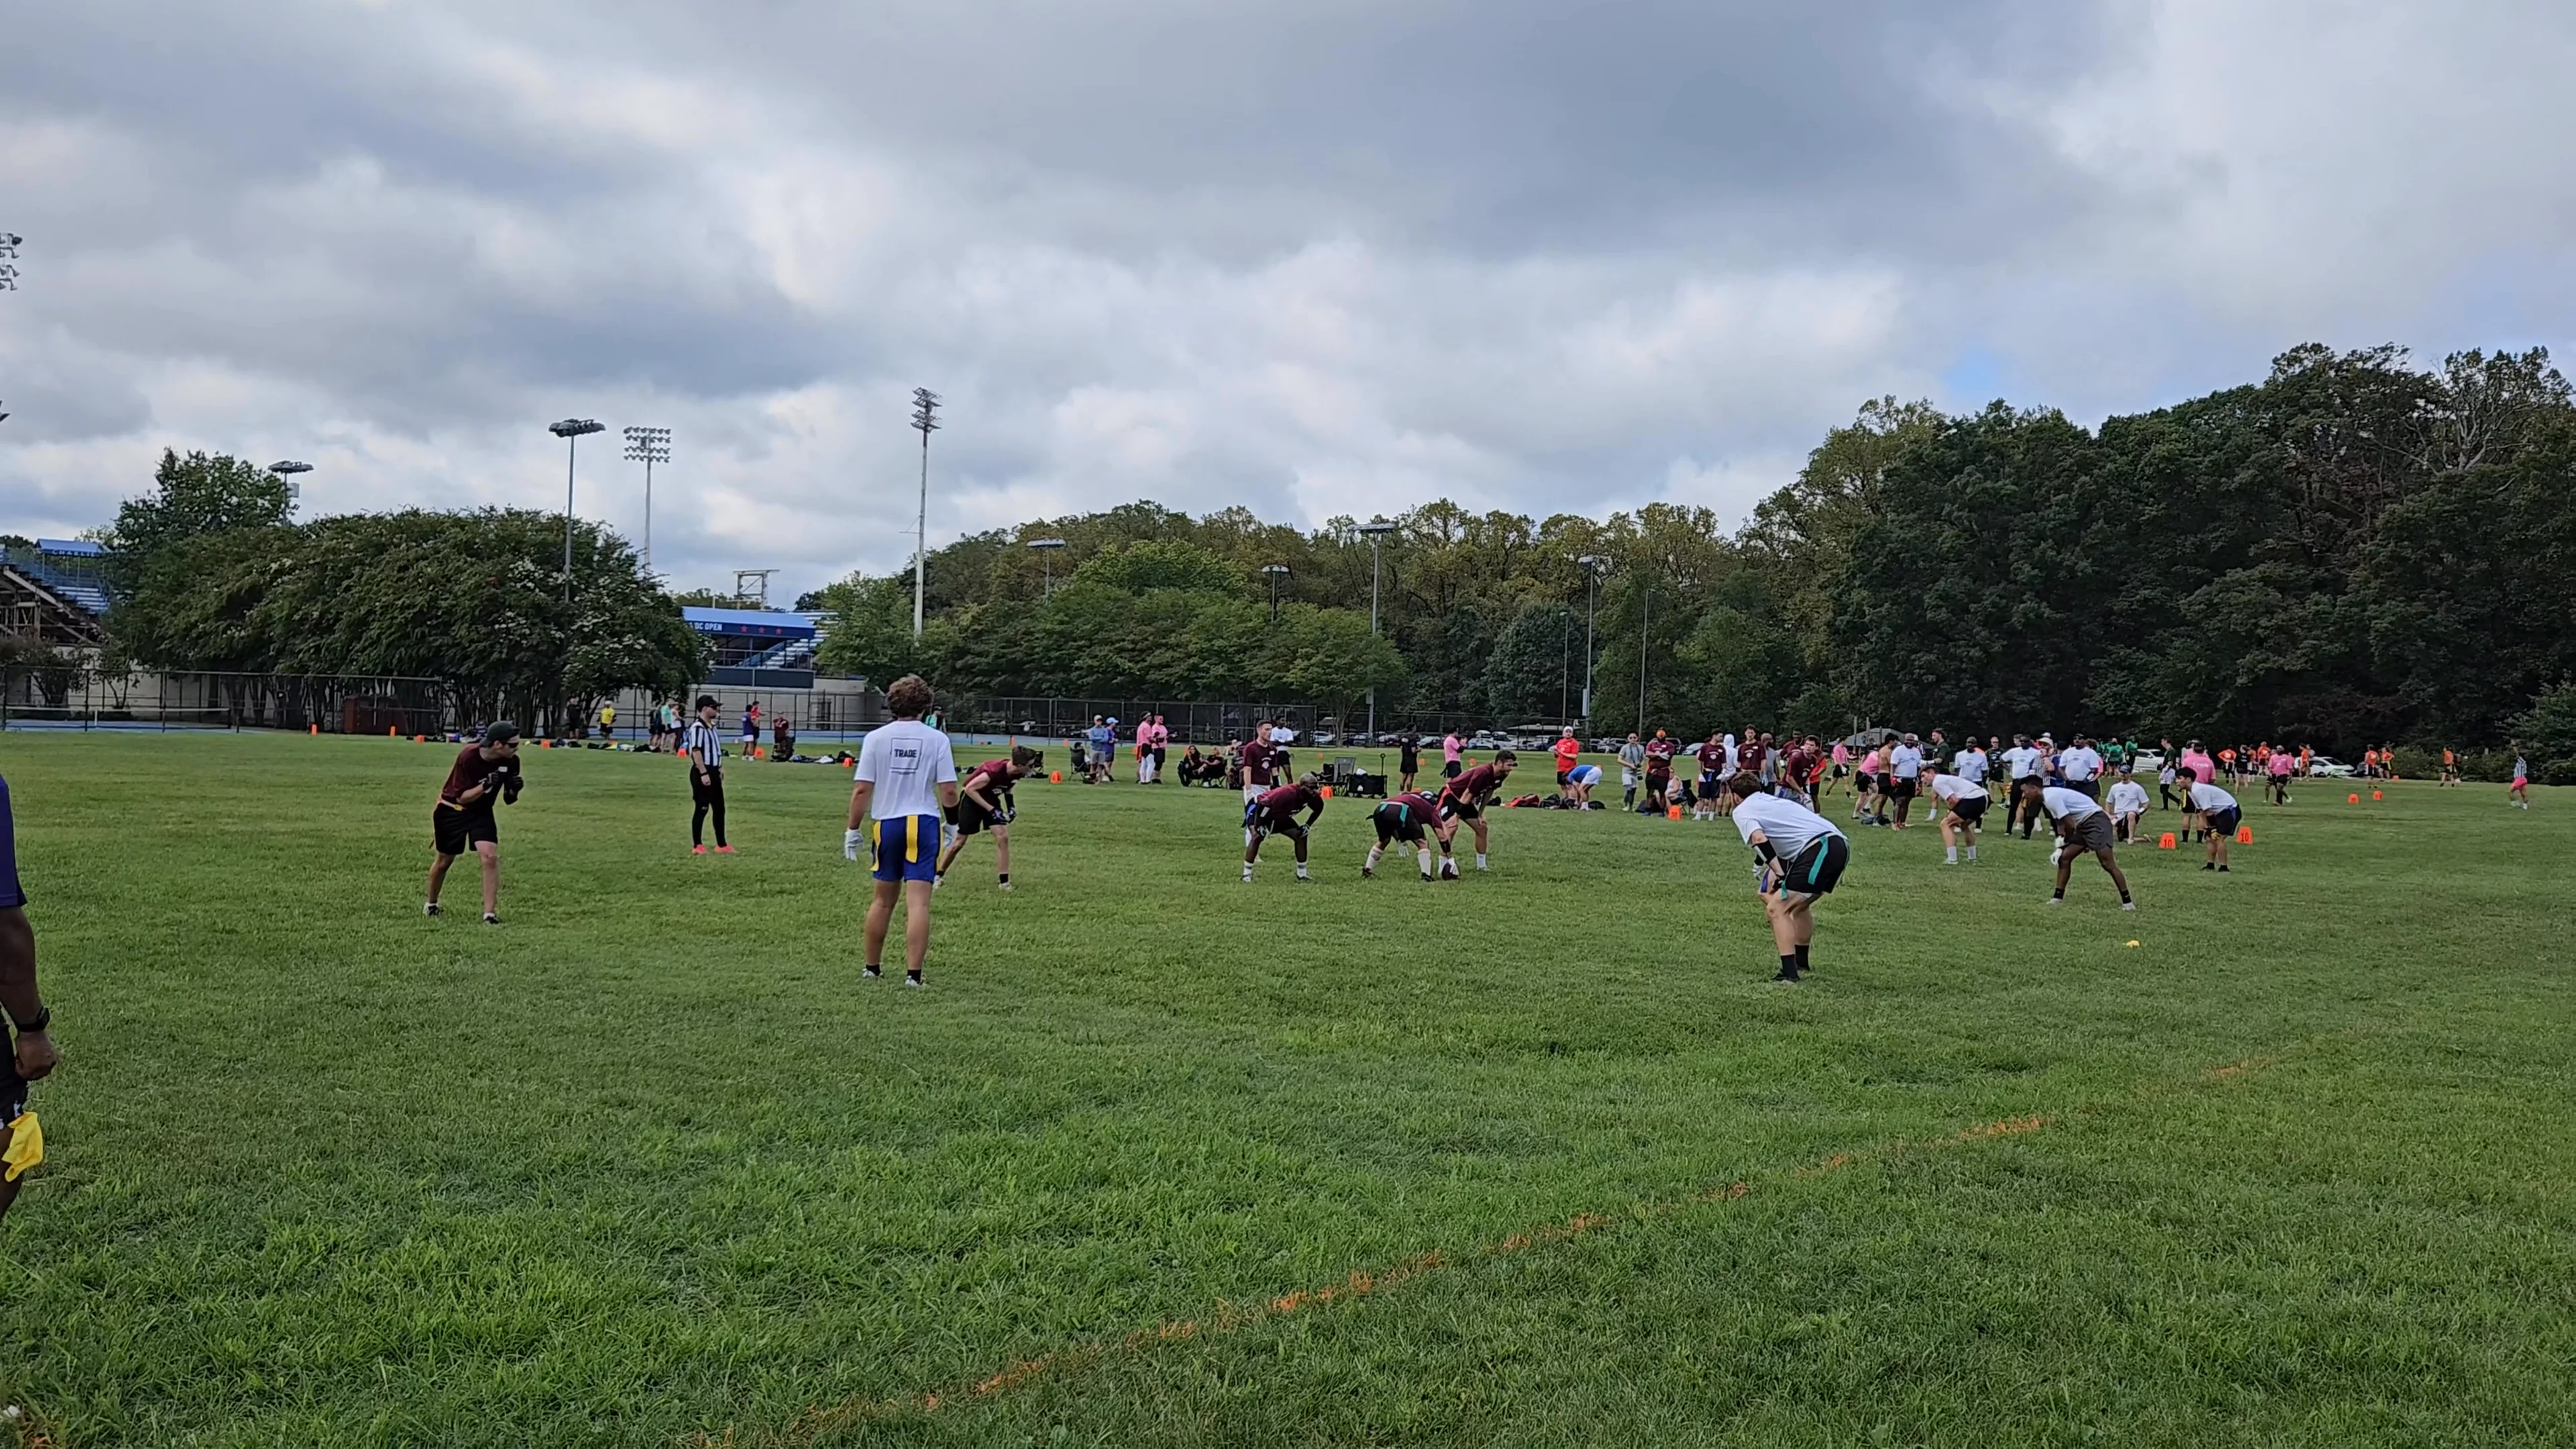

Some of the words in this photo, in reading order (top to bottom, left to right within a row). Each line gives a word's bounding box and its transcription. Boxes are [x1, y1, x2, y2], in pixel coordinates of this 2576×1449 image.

[695, 622, 704, 630] DC
[704, 623, 722, 631] OPEN
[894, 749, 917, 758] TRADE
[2241, 833, 2249, 842] 10
[2164, 839, 2172, 848] 10
